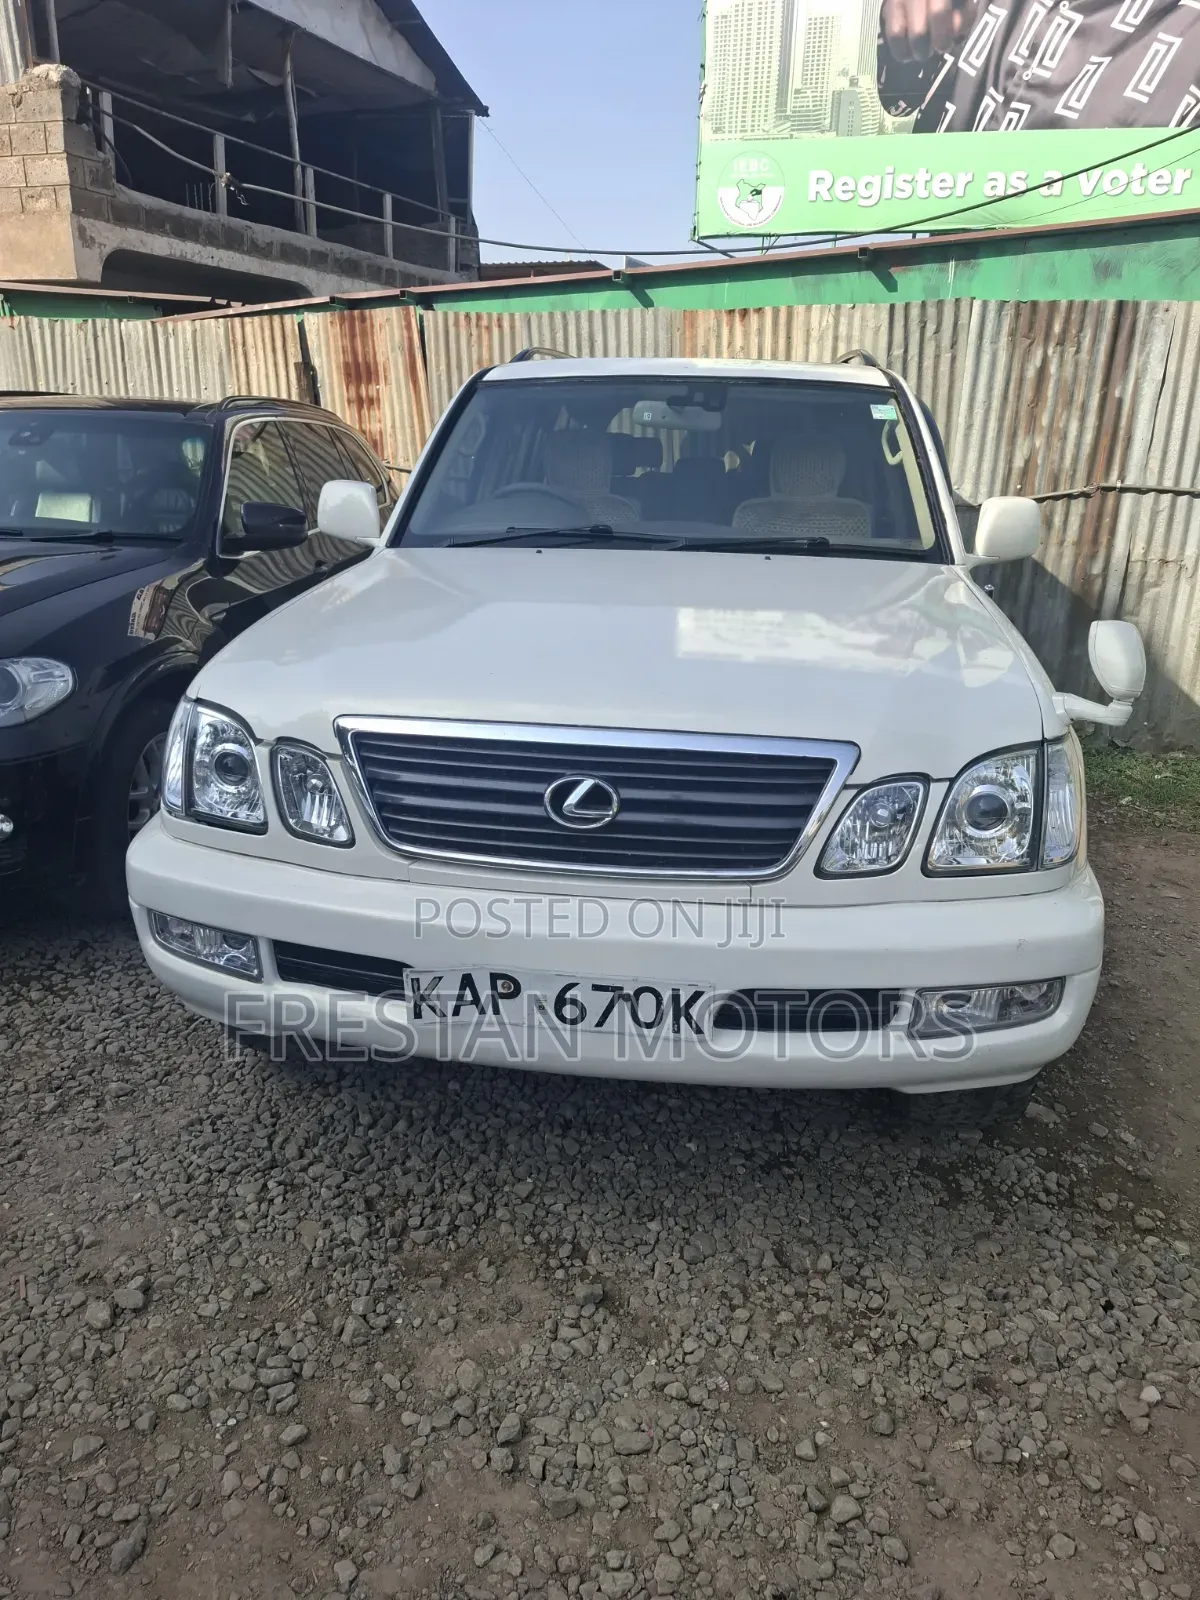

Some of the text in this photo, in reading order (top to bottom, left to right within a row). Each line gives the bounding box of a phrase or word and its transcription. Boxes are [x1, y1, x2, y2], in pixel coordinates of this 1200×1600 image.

[807, 162, 1193, 208] Register as a voter
[410, 972, 706, 1035] KAP 670K
